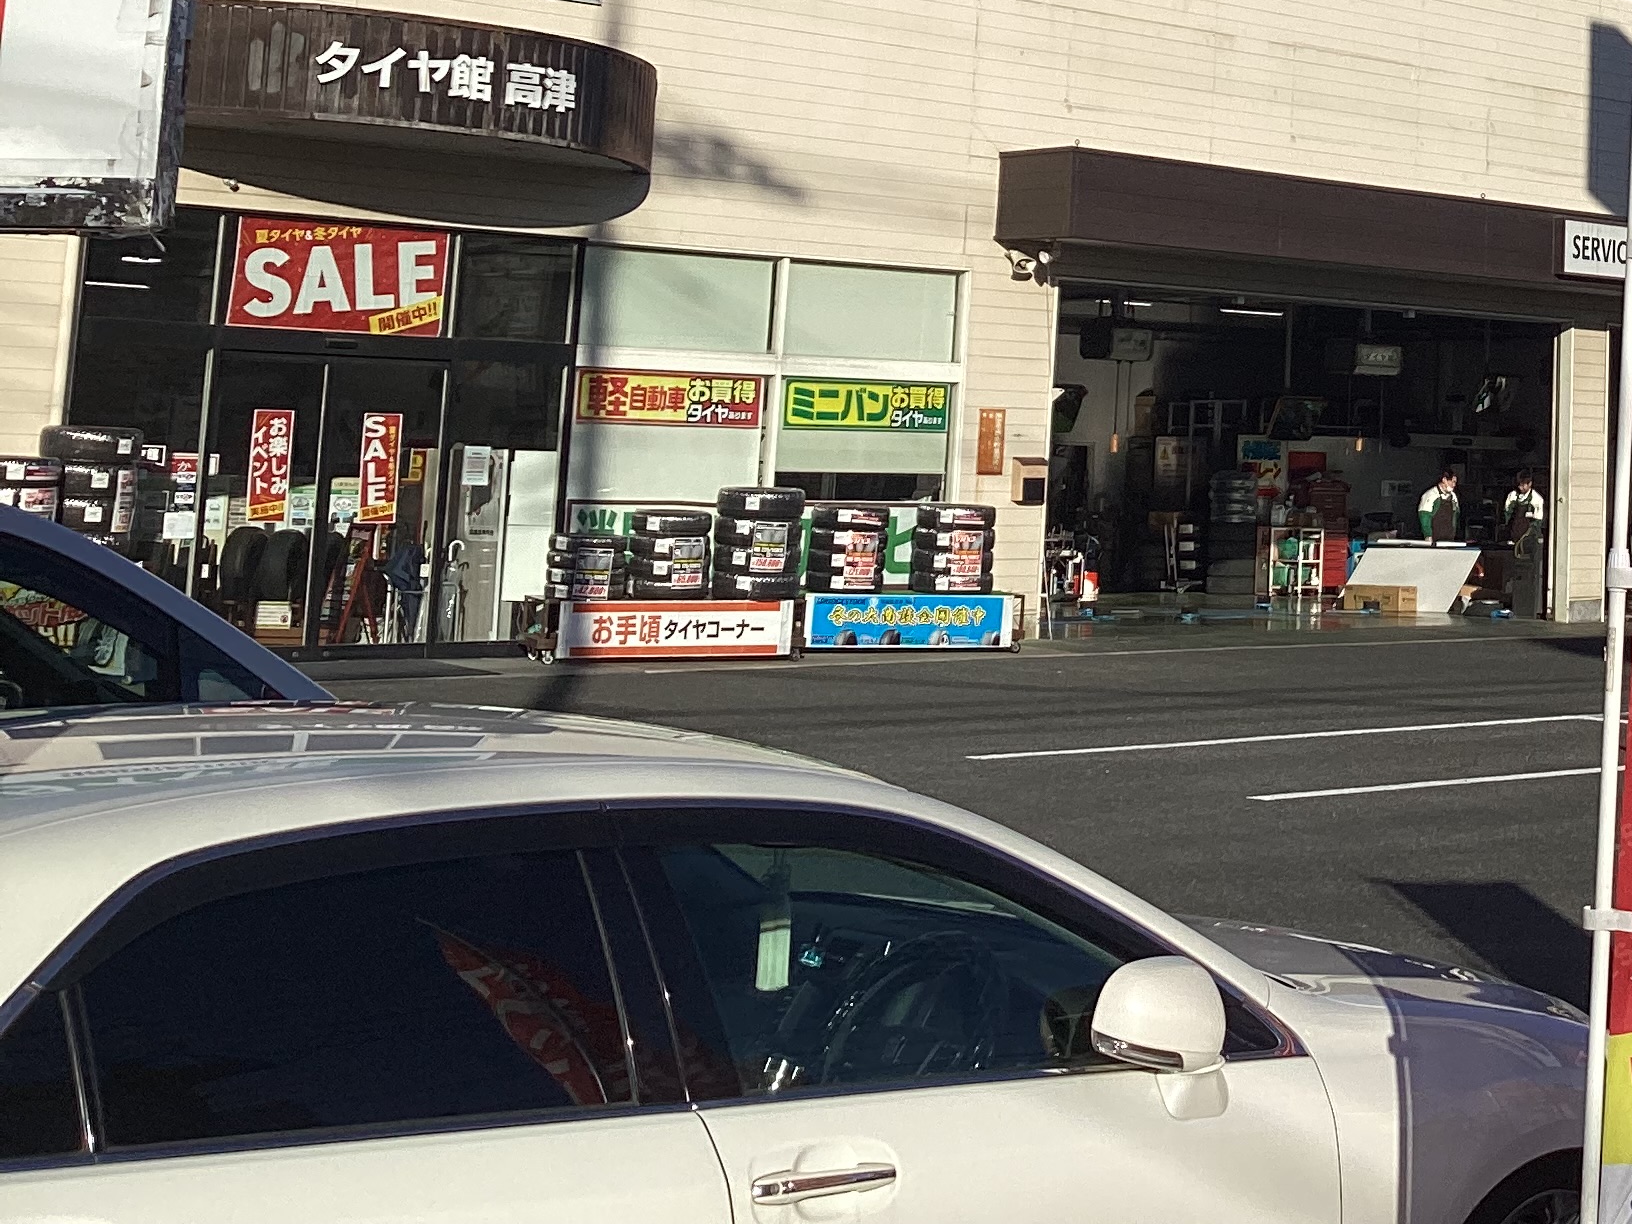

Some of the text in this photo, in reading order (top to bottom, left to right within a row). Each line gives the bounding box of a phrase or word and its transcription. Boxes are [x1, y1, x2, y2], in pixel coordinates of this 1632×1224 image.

[315, 41, 576, 113] タイヤ館 高津
[243, 240, 438, 318] SALE
[588, 376, 686, 417] 軽自動車
[790, 386, 890, 422] ミニバン
[252, 426, 268, 495] イベント
[269, 417, 288, 494] お楽しみ
[364, 416, 388, 506] SALE
